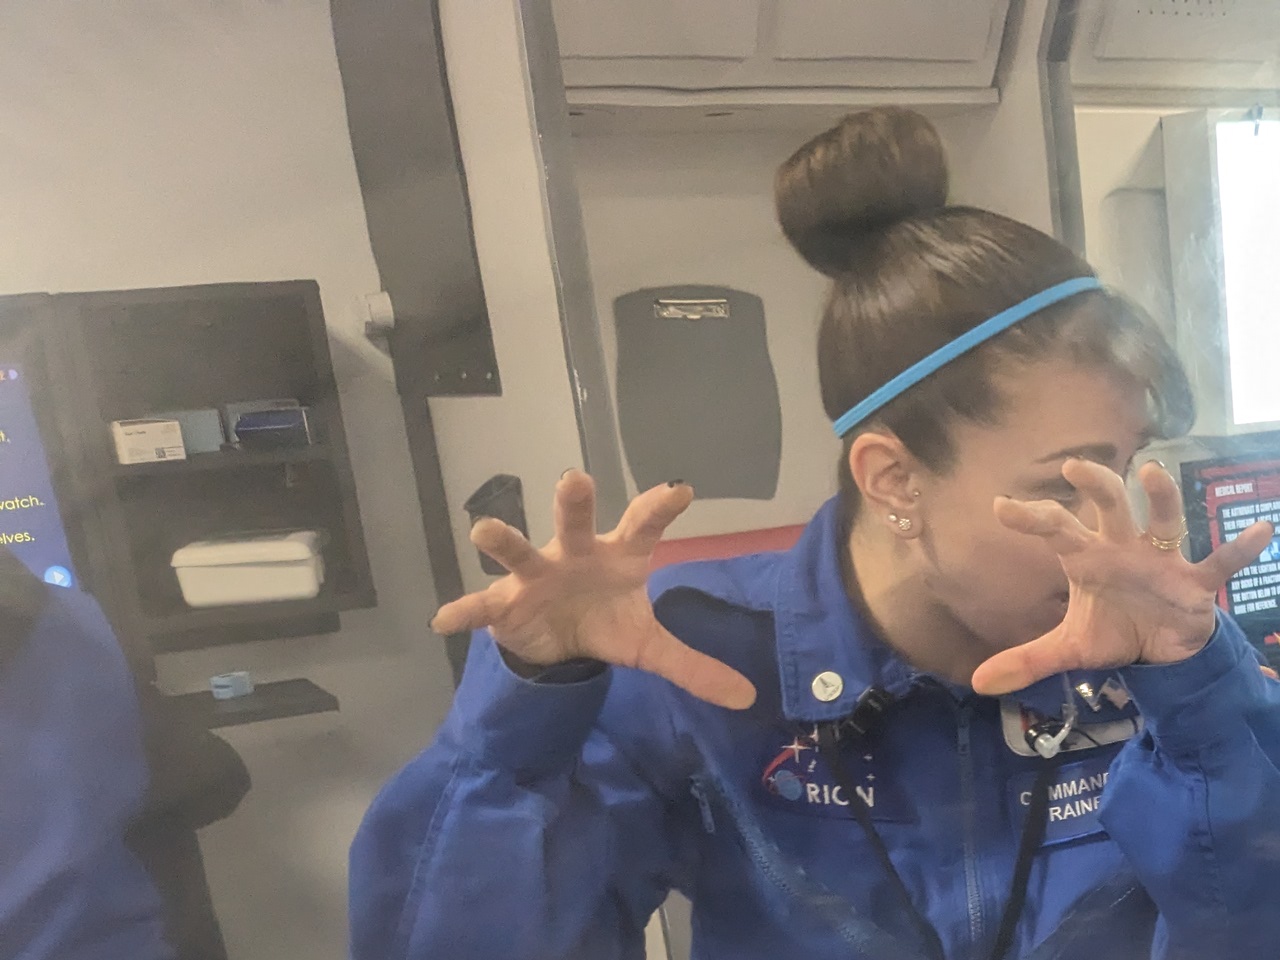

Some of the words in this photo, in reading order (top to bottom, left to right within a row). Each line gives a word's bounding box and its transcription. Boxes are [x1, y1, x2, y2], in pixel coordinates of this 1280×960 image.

[1215, 485, 1235, 497] MEDICAL
[1235, 483, 1252, 494] REPORT
[1020, 772, 1110, 806] CMMAN
